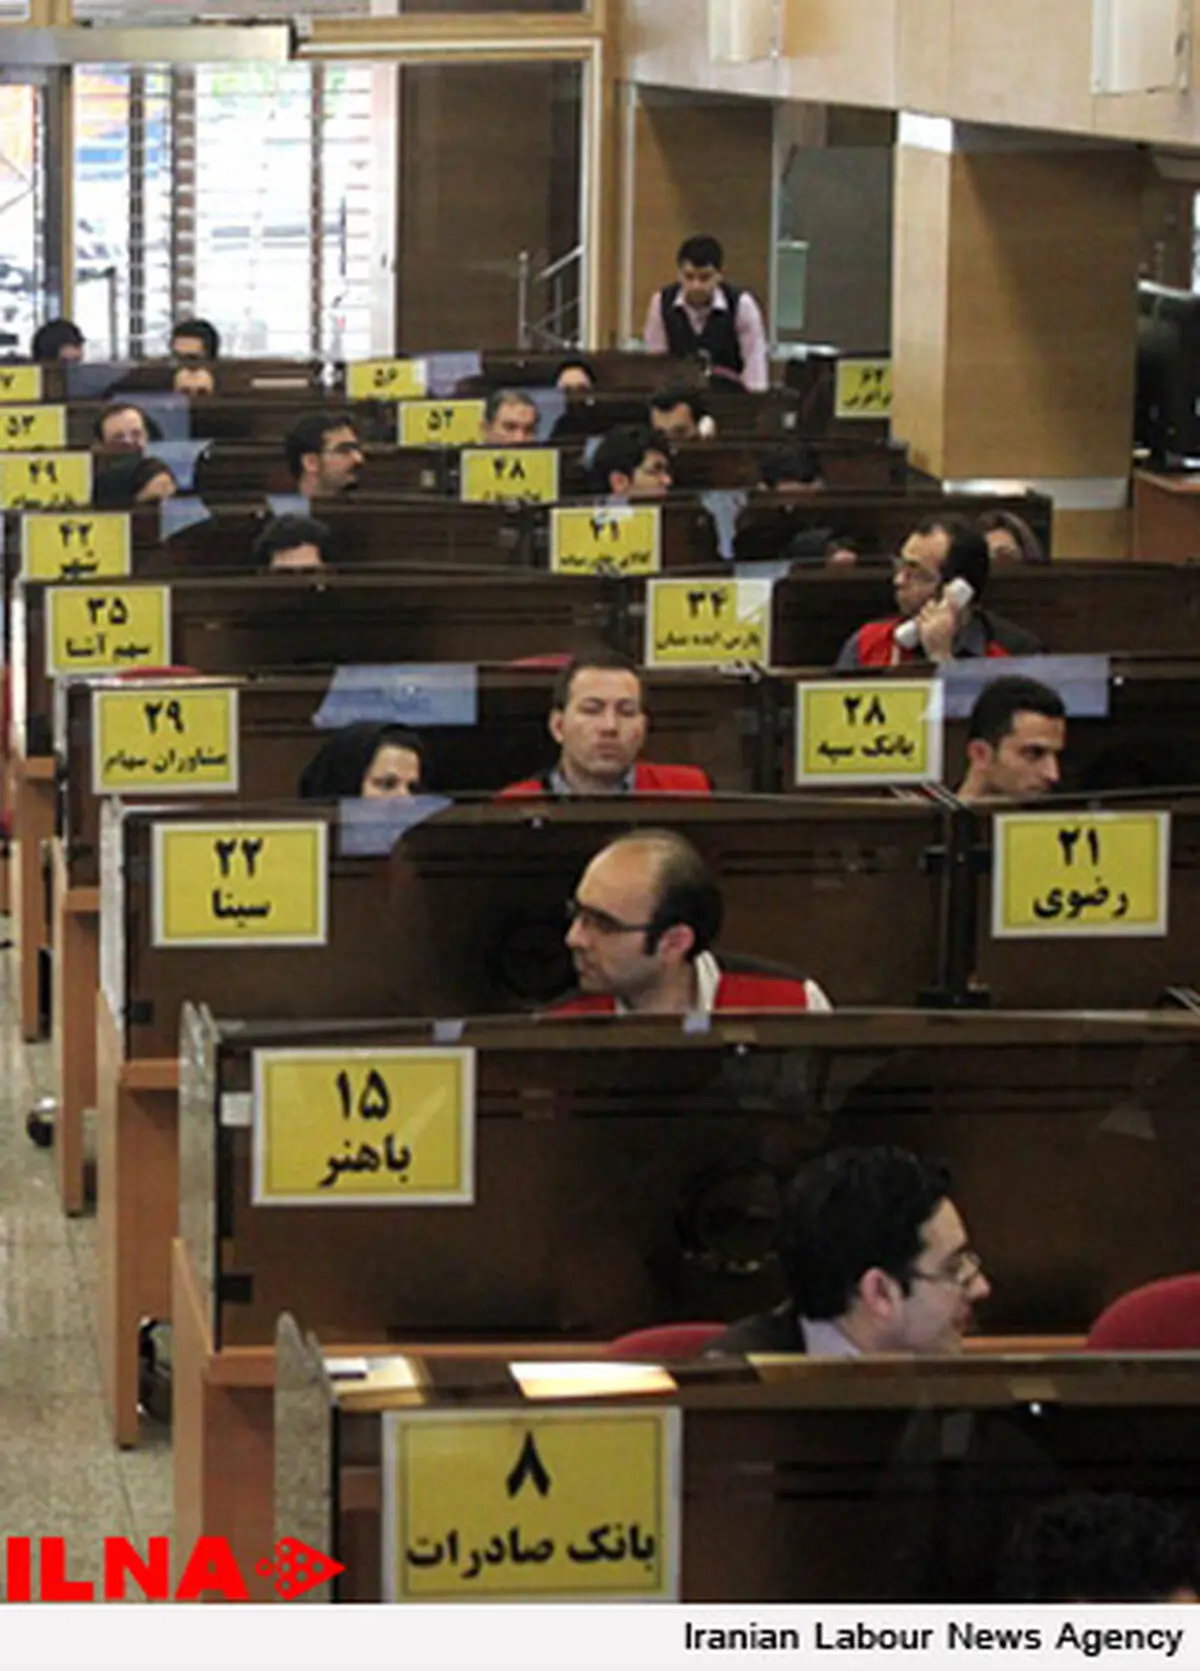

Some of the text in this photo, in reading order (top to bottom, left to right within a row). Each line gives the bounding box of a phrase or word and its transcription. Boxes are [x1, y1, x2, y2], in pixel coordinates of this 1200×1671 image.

[86, 597, 128, 625] ۳۵
[687, 586, 728, 619] ۳۴
[144, 700, 185, 735] ۲۹
[843, 694, 887, 726] ۲۸
[816, 734, 916, 765] بانک سپه
[213, 837, 264, 879] ۲۲
[1057, 827, 1100, 867] ۲۱
[211, 888, 272, 929] سینا
[1032, 876, 1129, 919] رضوی
[335, 1068, 392, 1122] ۱۵
[317, 1132, 413, 1188] باهنر
[505, 1429, 552, 1498] ۸
[405, 1522, 656, 1580] بانک صادرات
